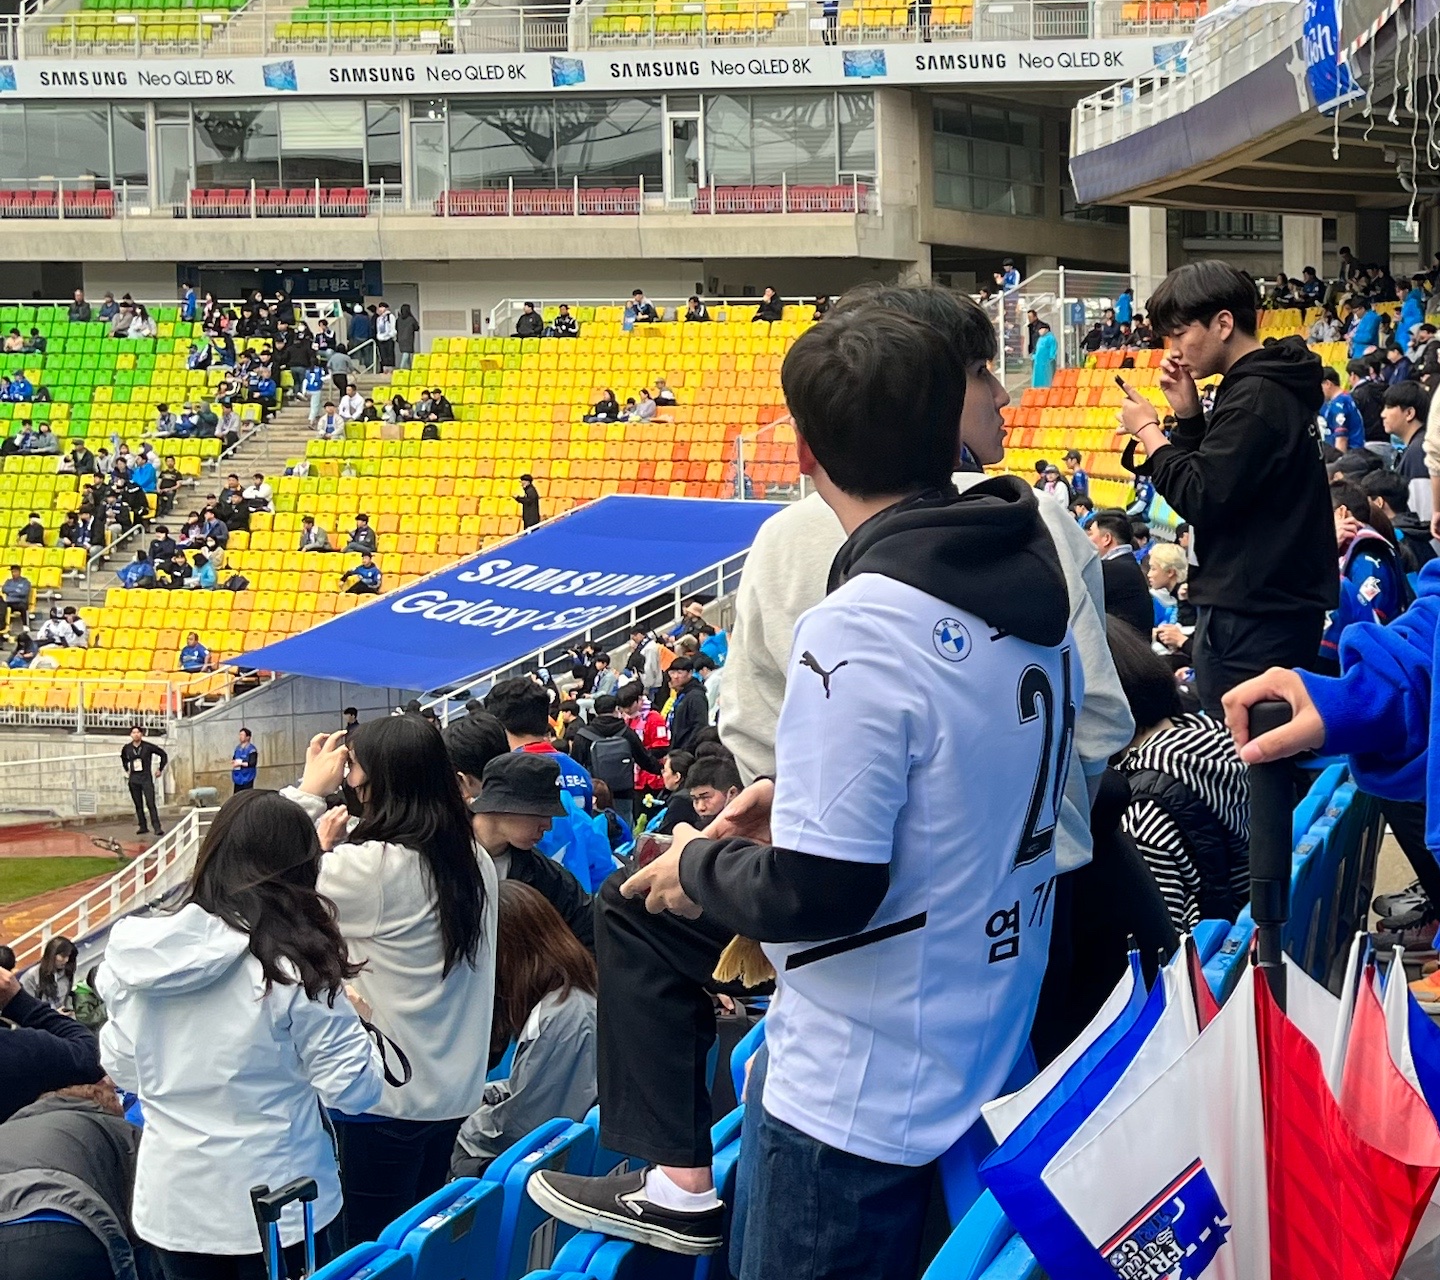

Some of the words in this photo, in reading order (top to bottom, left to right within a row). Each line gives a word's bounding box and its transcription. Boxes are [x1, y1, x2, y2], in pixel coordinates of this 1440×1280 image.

[610, 61, 700, 78] SAMSUNG
[711, 60, 745, 75] Neo
[748, 59, 789, 74] QLED
[792, 58, 811, 74] 8K
[915, 54, 1006, 70] SAMSUNG
[1018, 53, 1054, 68] Neo
[1057, 52, 1100, 68] QLED
[1103, 51, 1124, 67] 8K
[40, 71, 128, 86] SAMSUNG
[138, 71, 172, 86] Neo
[174, 70, 213, 85] QLED
[217, 70, 236, 85] 8K
[329, 67, 416, 82] SAMSUNG
[426, 66, 462, 81] Neo
[465, 65, 505, 80] QLED
[508, 64, 526, 80] 8K
[457, 559, 676, 597] SAMSUNG
[391, 590, 554, 636] Galaxy
[532, 604, 618, 631] S23
